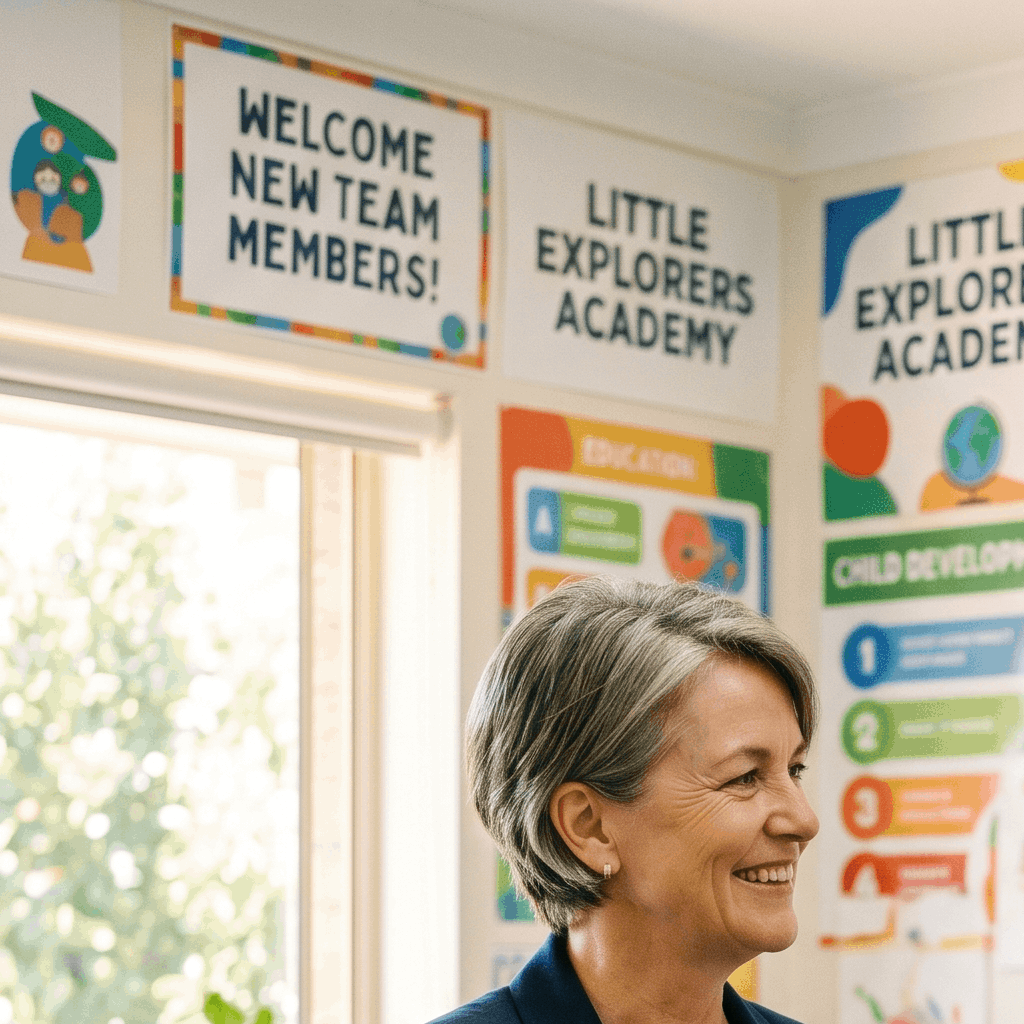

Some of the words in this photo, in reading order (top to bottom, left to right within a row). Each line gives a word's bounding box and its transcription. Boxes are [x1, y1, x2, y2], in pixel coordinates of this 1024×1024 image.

[239, 87, 434, 179] WELCOME
[230, 150, 319, 213] NEW
[334, 174, 441, 241] TEAM
[587, 183, 710, 252] LITTLE
[228, 215, 440, 302] MEMBERS!
[536, 228, 755, 316] EXPLORERS
[555, 292, 738, 366] ACADEMY
[832, 549, 903, 589] CHILD
[859, 636, 878, 676] 1
[852, 710, 880, 751] 2
[853, 785, 880, 830] 3
